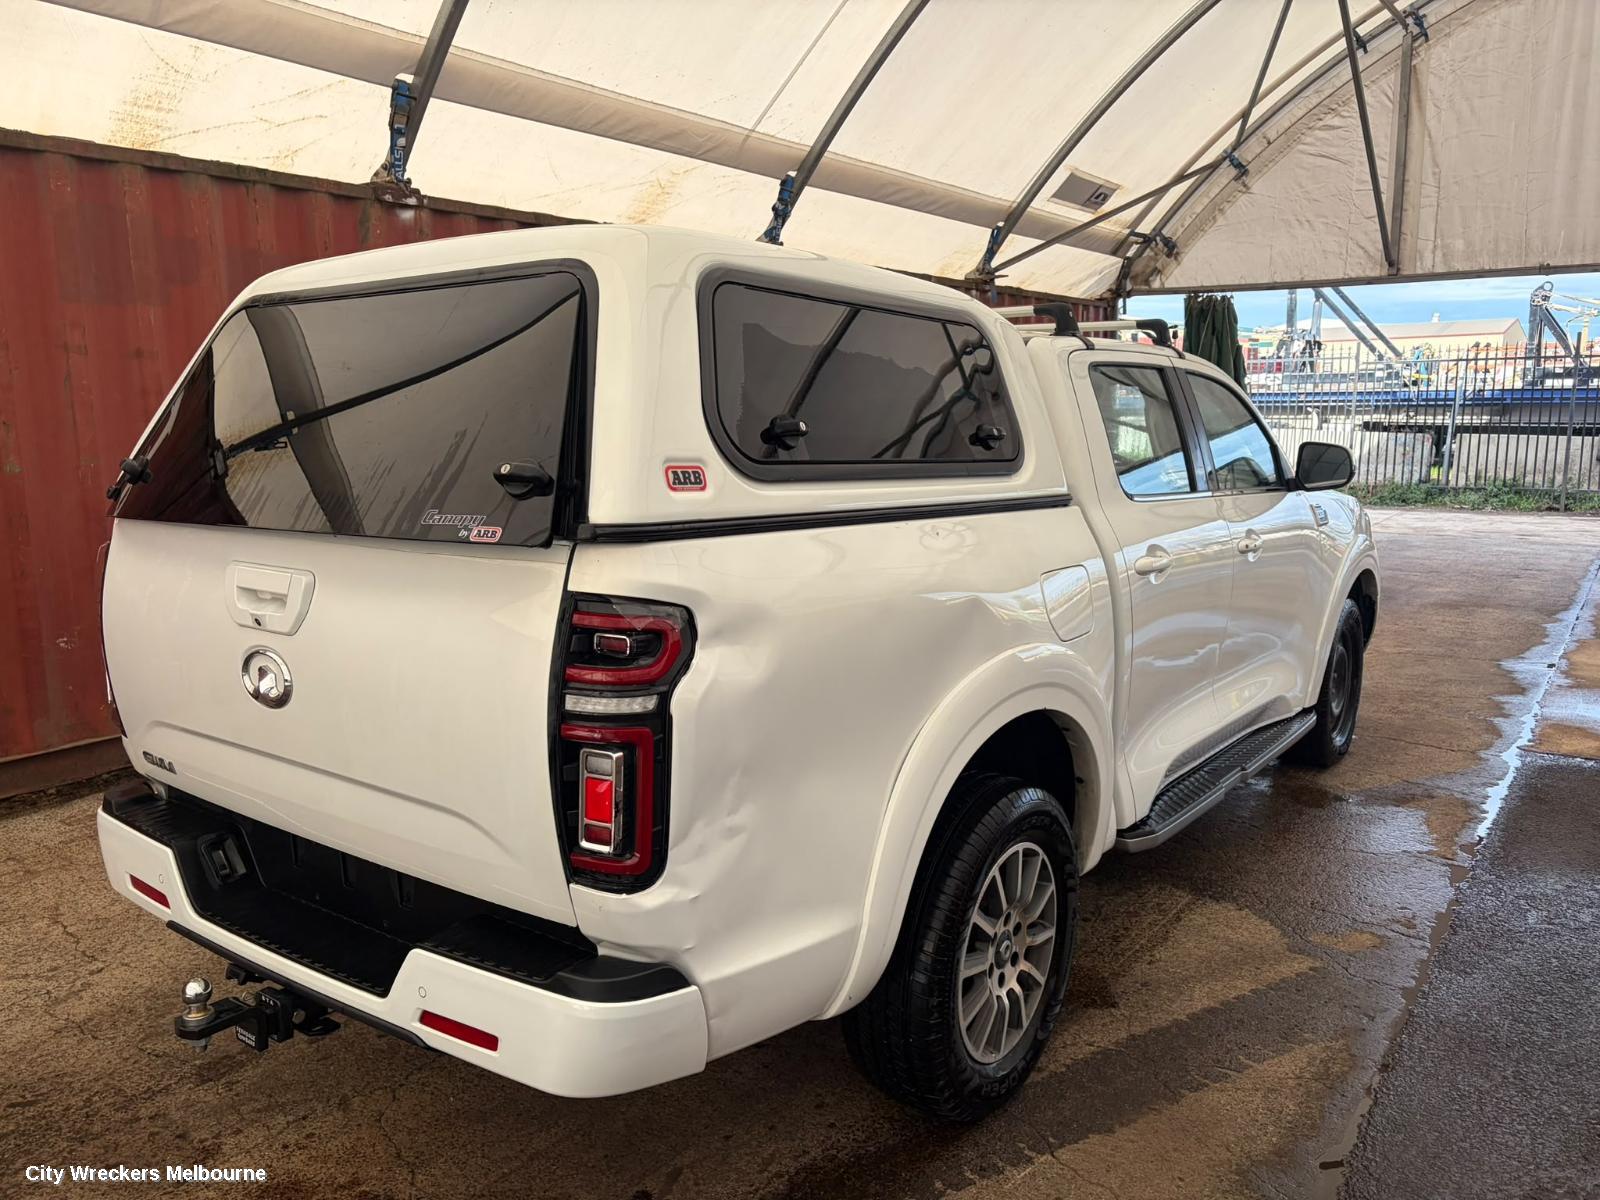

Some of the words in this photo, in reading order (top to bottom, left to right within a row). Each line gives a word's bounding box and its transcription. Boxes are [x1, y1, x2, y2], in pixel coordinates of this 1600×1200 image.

[670, 469, 704, 486] ARB
[421, 509, 486, 528] Canopy
[458, 529, 468, 538] by
[472, 529, 498, 540] ARB
